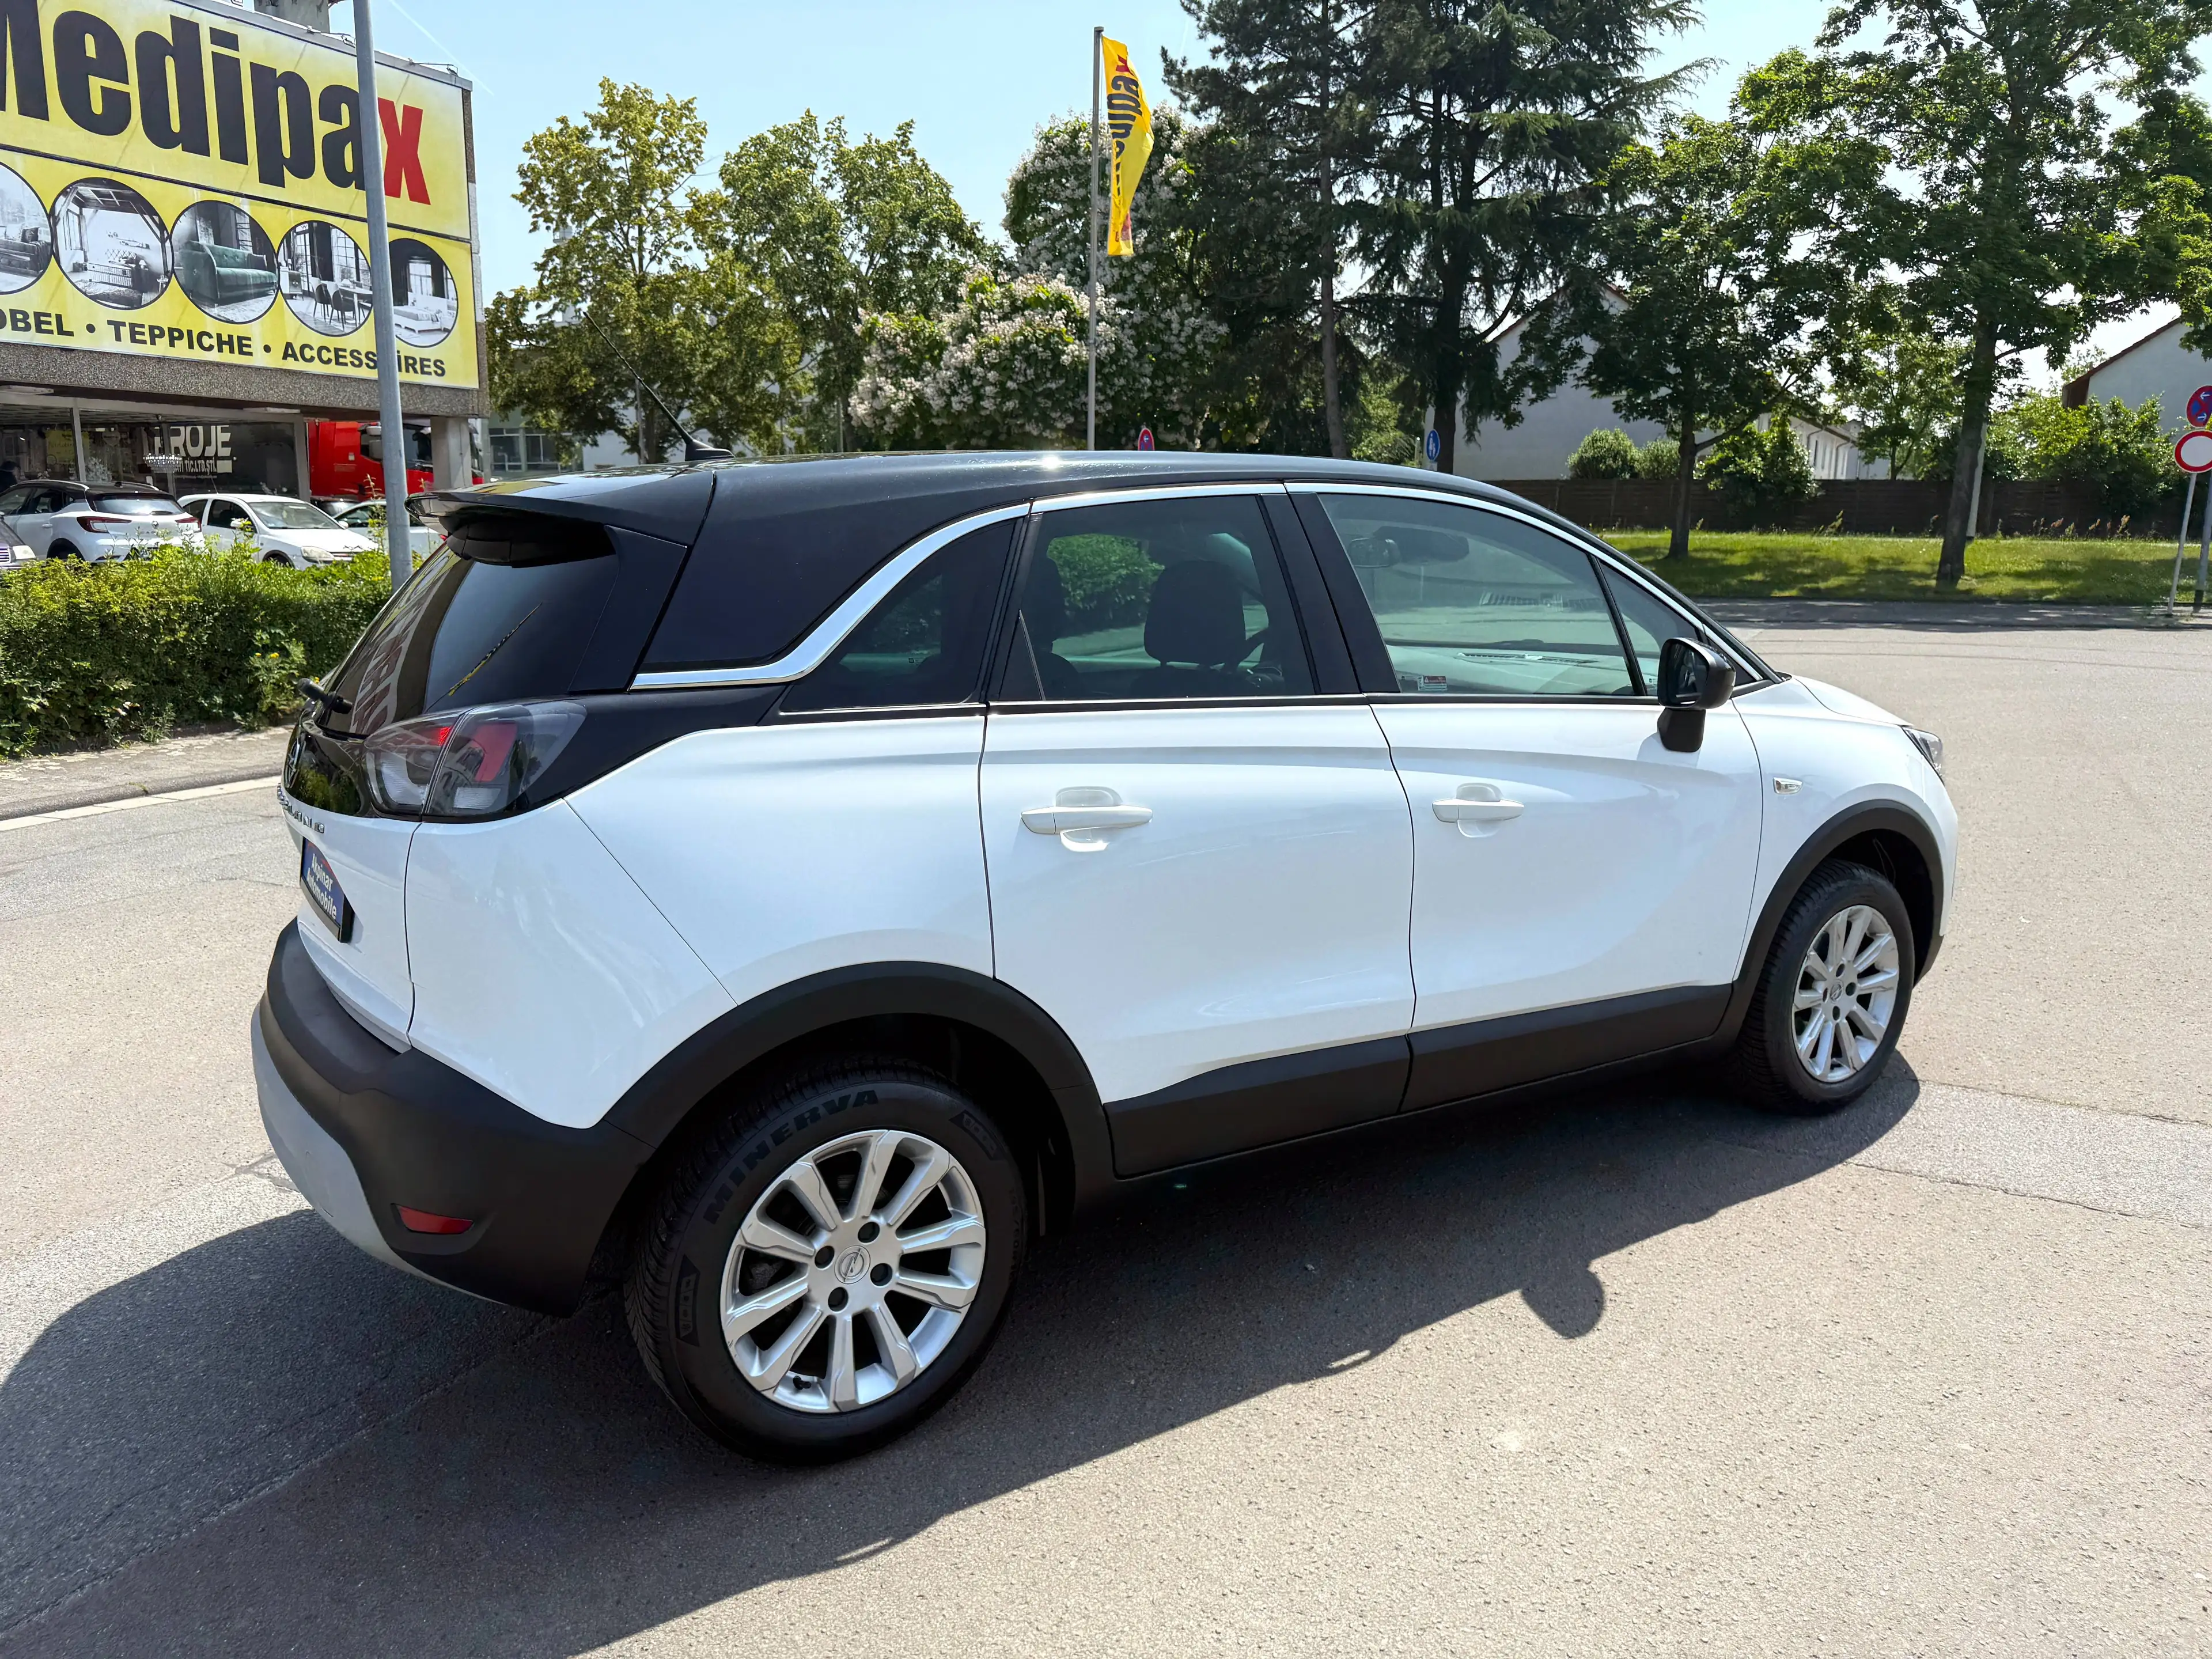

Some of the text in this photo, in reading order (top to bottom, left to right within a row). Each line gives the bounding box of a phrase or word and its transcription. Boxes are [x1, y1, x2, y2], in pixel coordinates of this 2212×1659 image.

[107, 320, 253, 357] TEPPICHE
[306, 867, 337, 919] Automobile
[703, 1089, 879, 1225] MINERVA
